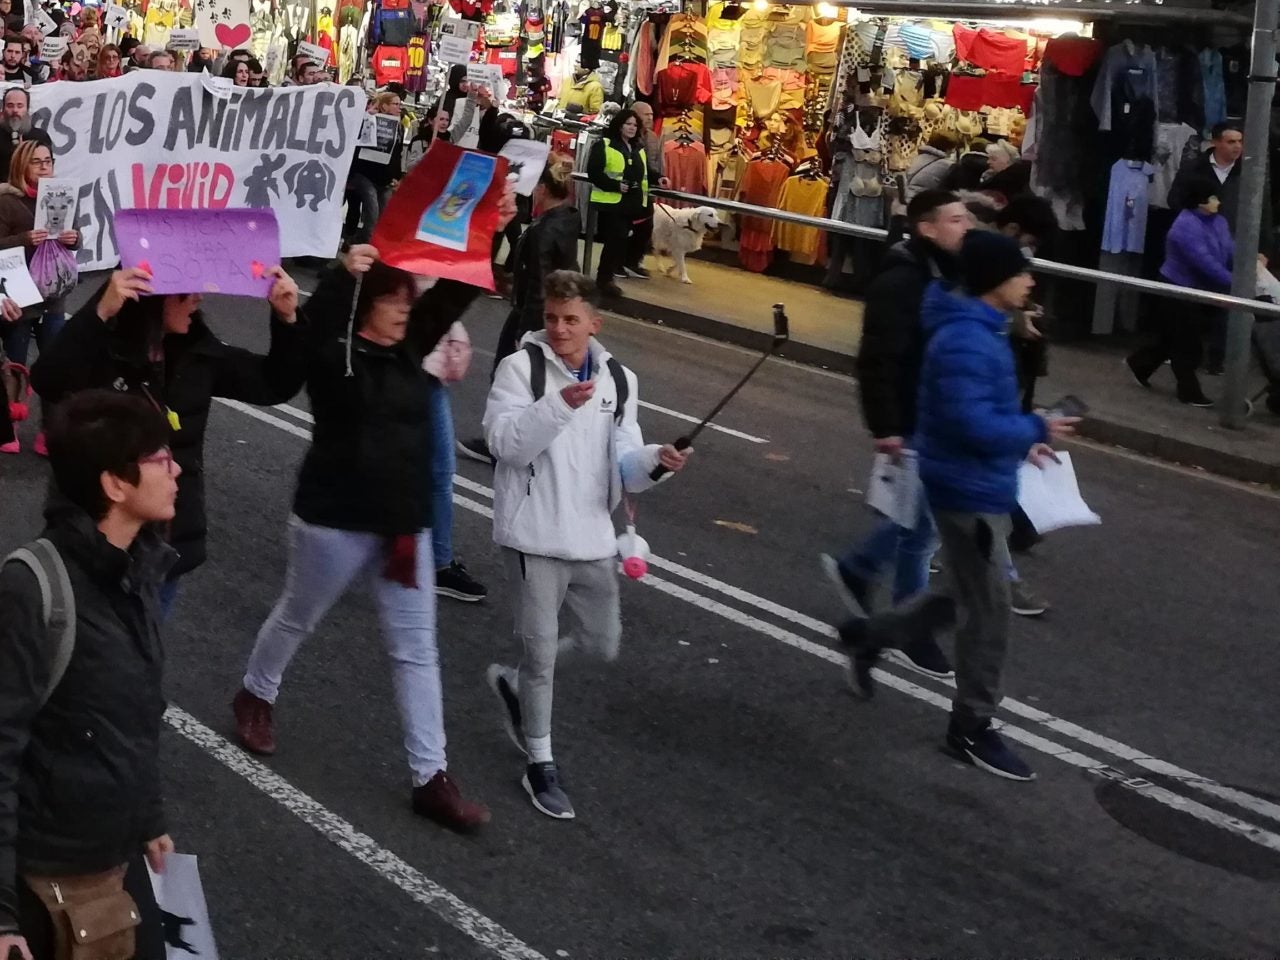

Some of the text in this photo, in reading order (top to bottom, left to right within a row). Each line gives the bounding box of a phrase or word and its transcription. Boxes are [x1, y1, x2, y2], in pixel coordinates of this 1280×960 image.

[408, 46, 425, 68] 10
[89, 82, 156, 154] LOS
[158, 253, 250, 284] SOTA
